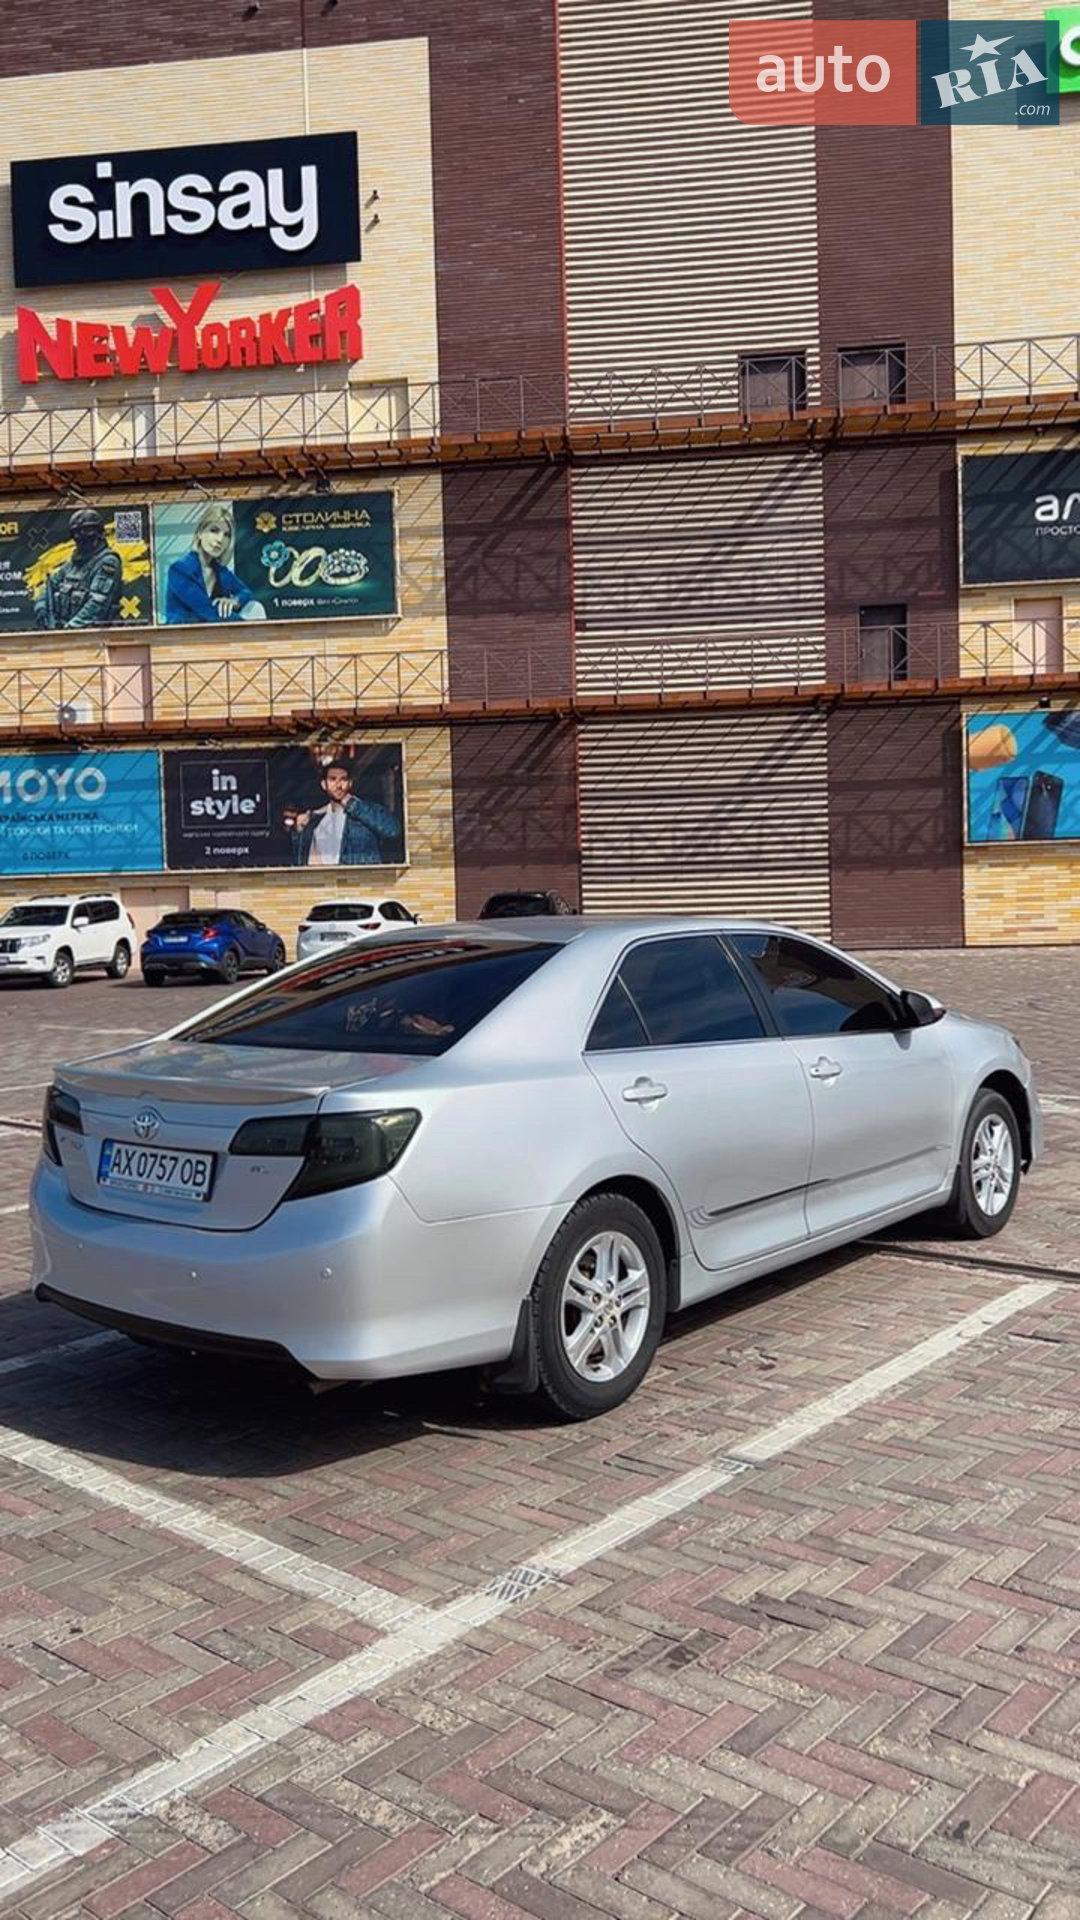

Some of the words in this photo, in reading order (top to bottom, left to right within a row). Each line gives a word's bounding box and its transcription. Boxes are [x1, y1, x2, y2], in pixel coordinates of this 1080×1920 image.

[48, 161, 319, 251] sinsay
[282, 509, 371, 525] СТОЛИЧНА
[273, 597, 280, 607] 1
[211, 768, 238, 791] in
[204, 846, 212, 855] 2
[212, 845, 250, 856] поверх
[111, 1148, 136, 1177] AX
[136, 1152, 180, 1182] 0757
[180, 1158, 208, 1187] OB
